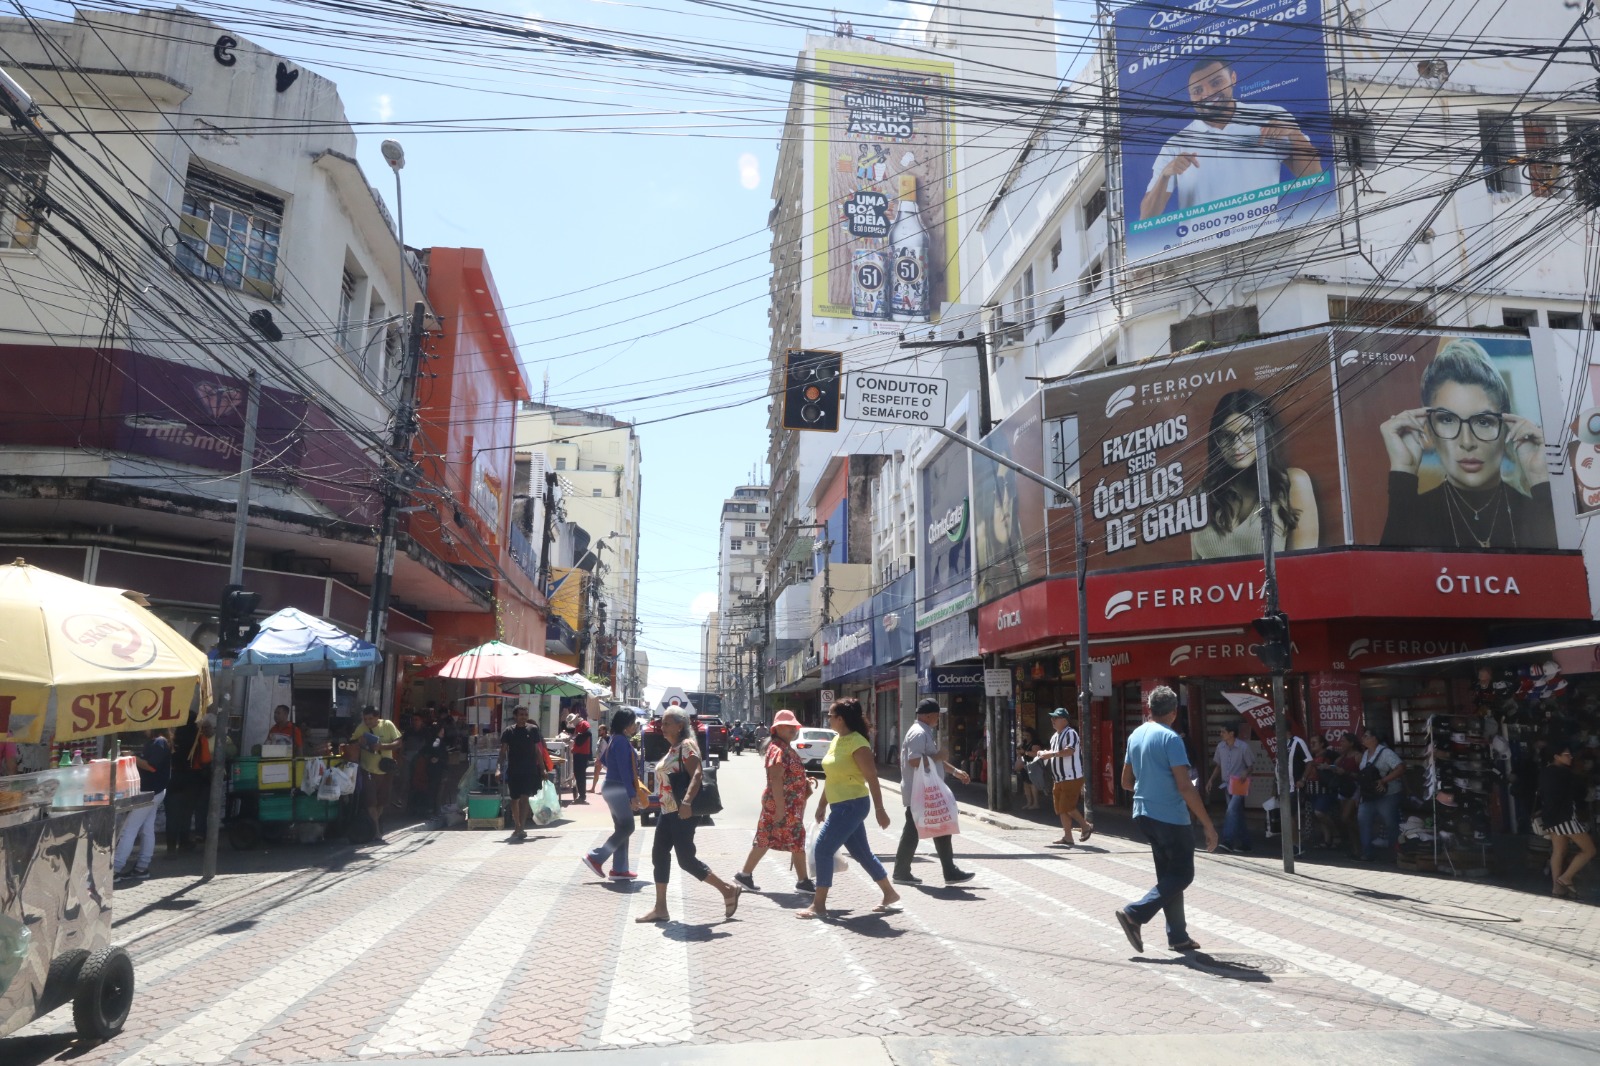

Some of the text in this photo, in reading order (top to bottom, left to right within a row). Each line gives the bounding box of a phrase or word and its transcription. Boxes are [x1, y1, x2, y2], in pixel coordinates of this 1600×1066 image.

[1249, 2, 1276, 18] quem
[1169, 17, 1193, 29] melhor
[1143, 31, 1221, 71] MELHOR
[1225, 21, 1258, 45] por
[1262, 0, 1308, 27] você
[850, 121, 912, 137] ASSADO
[856, 194, 886, 207] UMA
[1133, 175, 1326, 231] FAÇA AGORA UMA AVALIAÇÃO AQUI EMBAIXO
[847, 203, 876, 216] BOA
[1191, 203, 1278, 233] 0800 790 8080
[862, 268, 878, 286] 51
[901, 262, 916, 284] 51
[1361, 351, 1416, 363] FERROVIA
[856, 377, 938, 395] CONDUTOR
[1141, 367, 1237, 397] FERROVIA
[862, 392, 931, 407] RESPEITE O
[862, 406, 929, 421] SEMÁFORO
[1102, 414, 1189, 466] FAZEMOS
[1127, 451, 1157, 475] SEUS
[1093, 477, 1184, 519] ÓCULOS
[1106, 491, 1209, 553] DE GRAU
[1435, 566, 1521, 595] ÓTICA
[997, 609, 1022, 631] ÓTICA
[1372, 640, 1470, 655] FERROVIA
[1332, 661, 1346, 670] 136
[1318, 690, 1349, 698] COMPRE
[71, 685, 182, 734] SKOL
[1248, 705, 1274, 719] Faça
[1319, 704, 1349, 712] GANHE
[1320, 712, 1350, 720] OUTRO
[1256, 713, 1276, 729] Aqu
